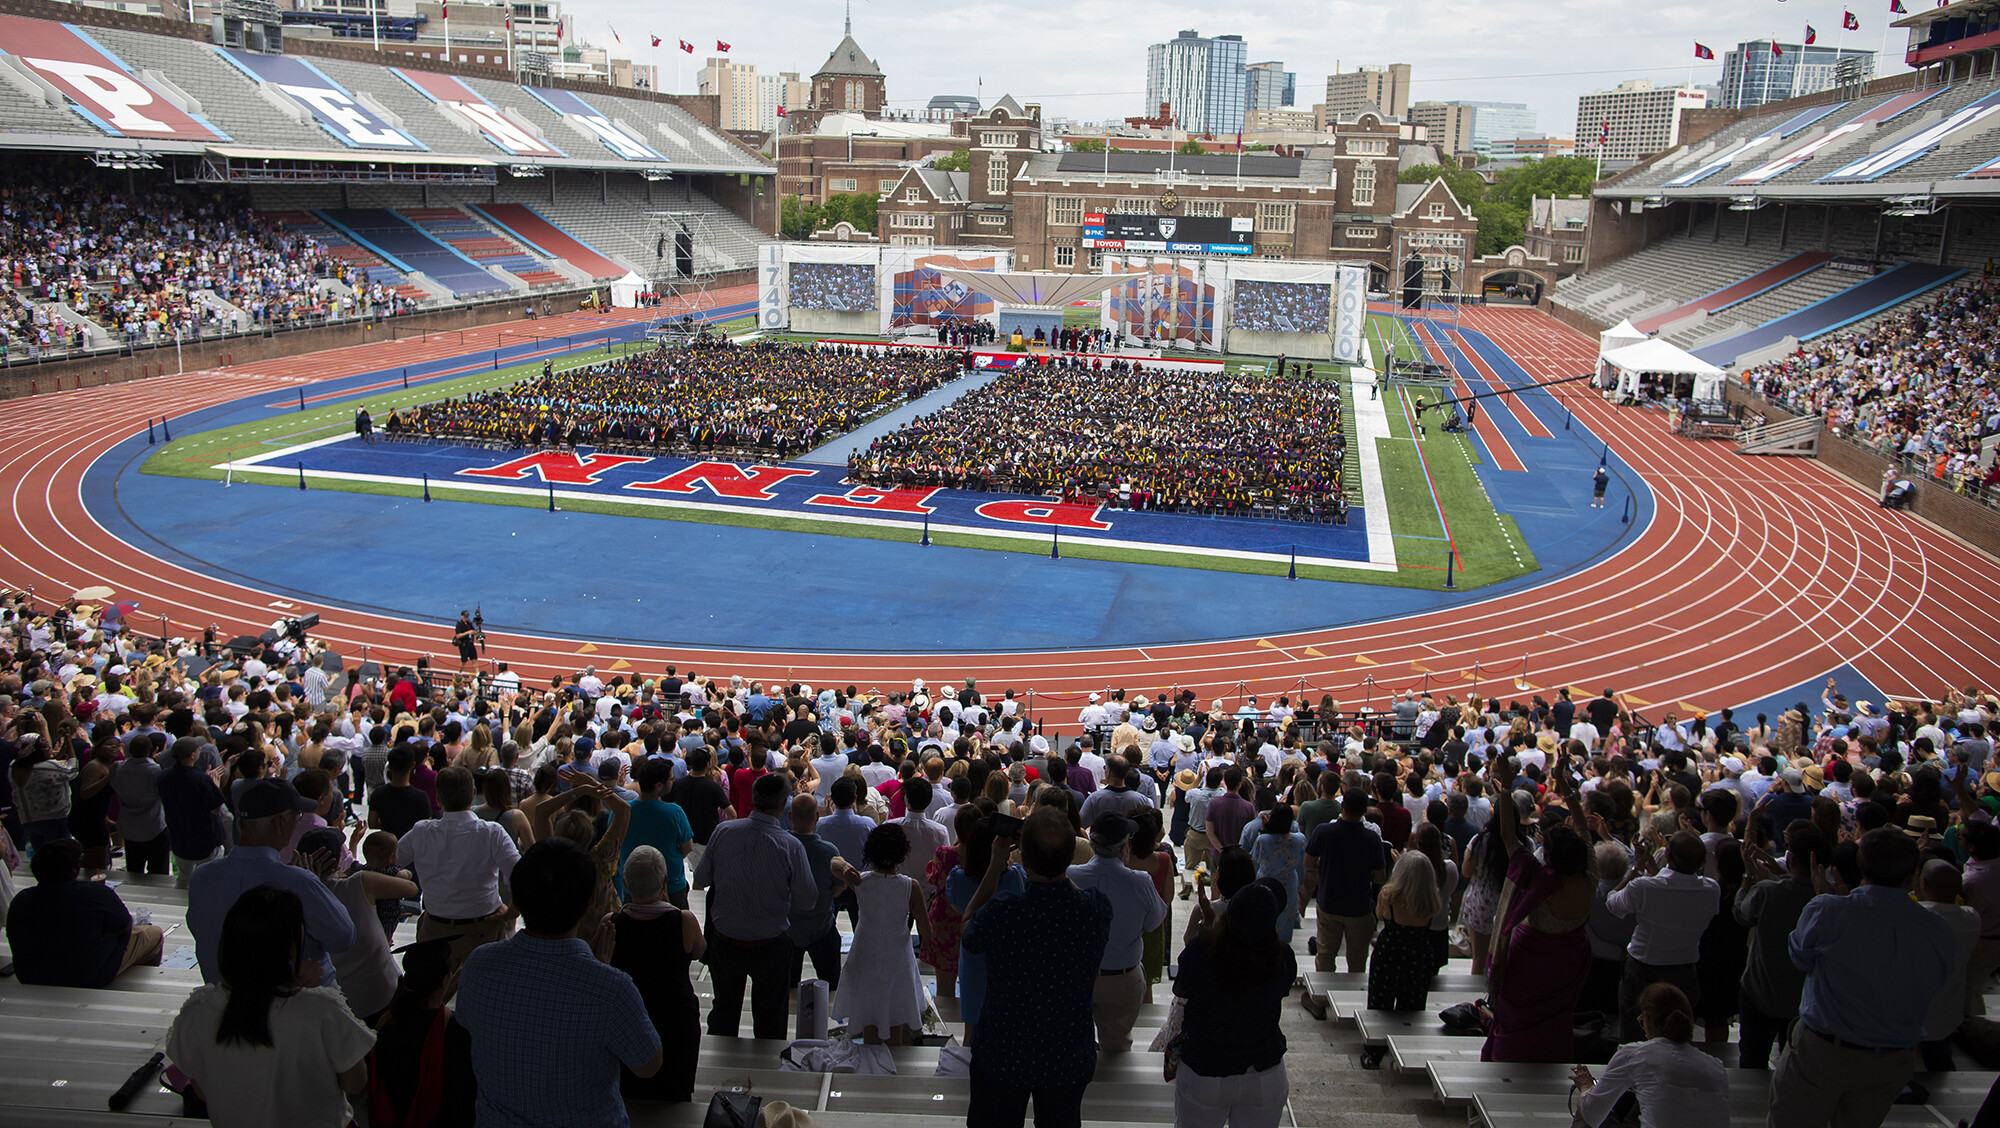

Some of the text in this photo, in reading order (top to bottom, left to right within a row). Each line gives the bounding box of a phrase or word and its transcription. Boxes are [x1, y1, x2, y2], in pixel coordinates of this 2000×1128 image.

[1094, 206, 1221, 218] FRANKLIN FIELD
[1172, 243, 1202, 251] GEICO
[765, 246, 782, 327] 1740
[1339, 269, 1358, 358] 2020
